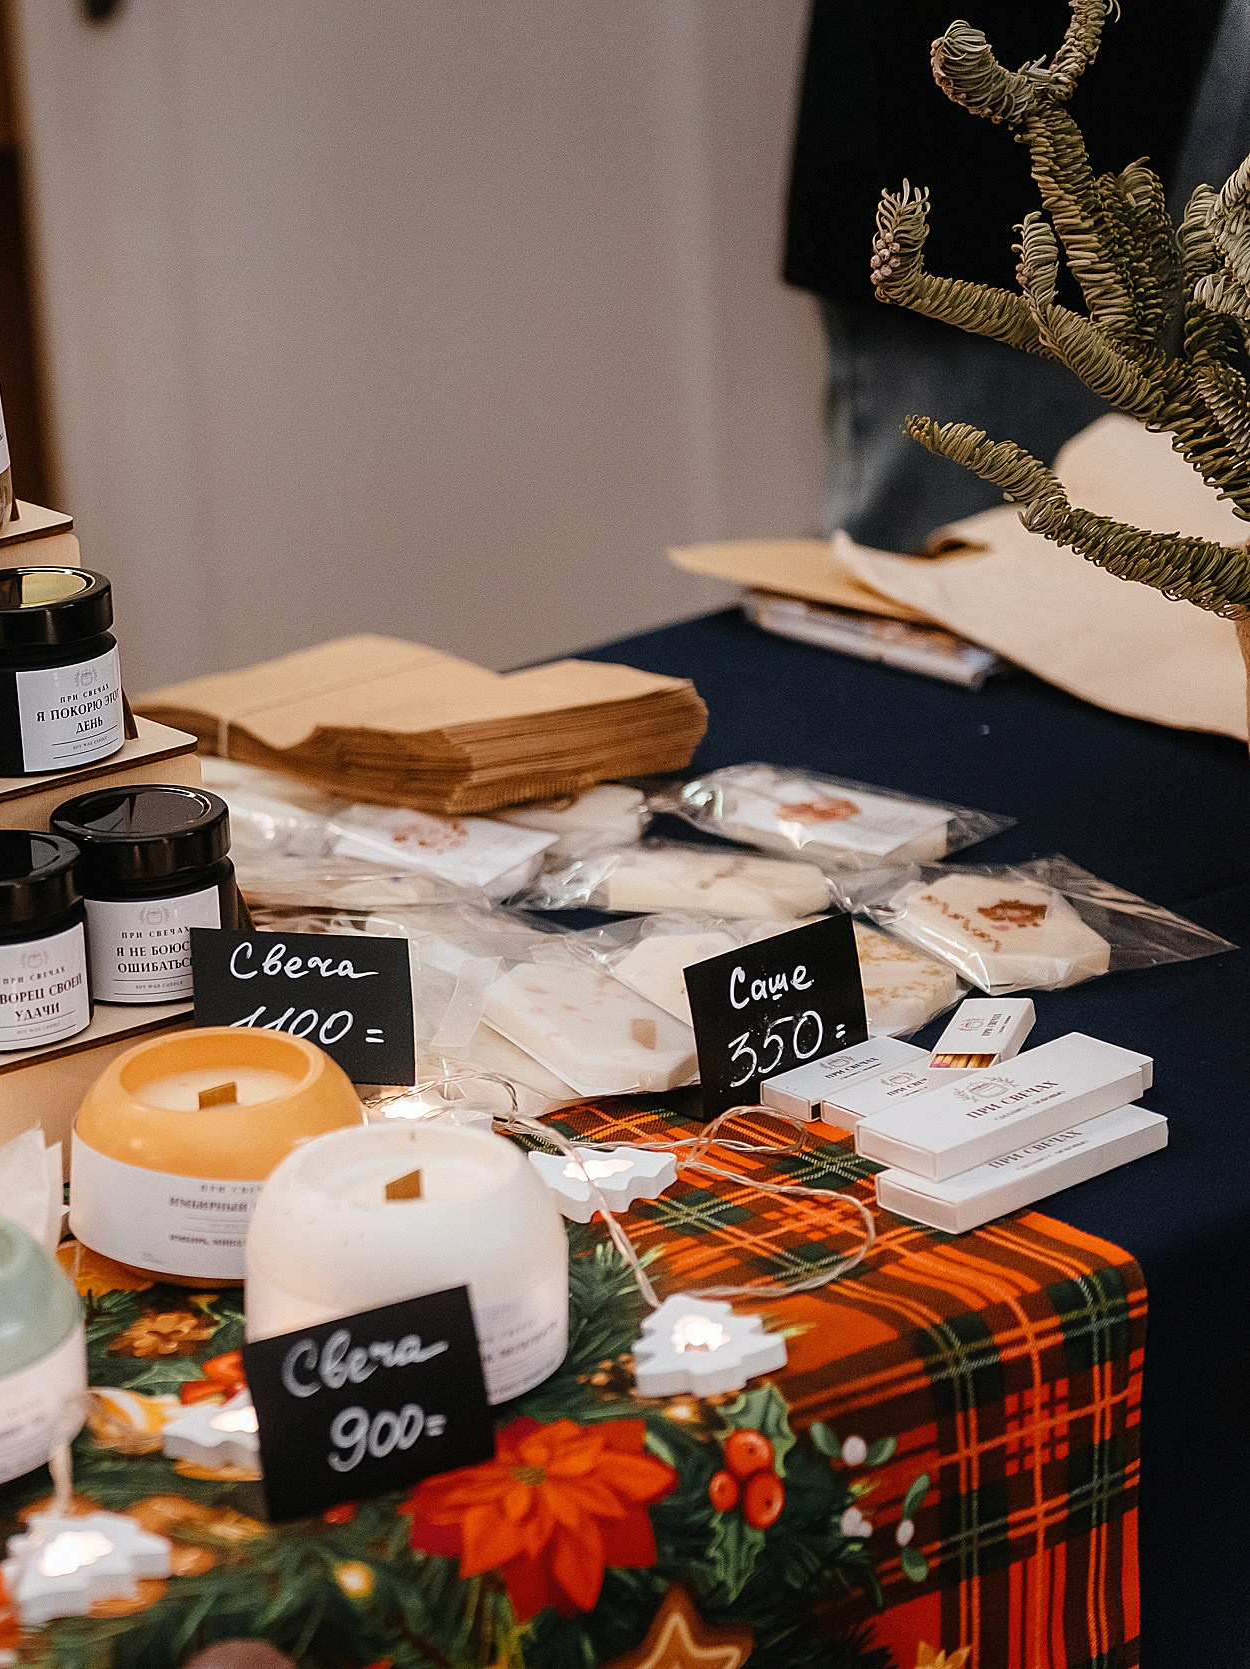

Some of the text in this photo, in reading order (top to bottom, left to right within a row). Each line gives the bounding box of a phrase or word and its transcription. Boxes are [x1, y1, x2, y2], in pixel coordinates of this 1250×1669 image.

[60, 683, 109, 703] ПРИ СВЕЧАХ
[37, 711, 45, 722] Я
[51, 699, 103, 720] ПОКОРЮ
[76, 717, 103, 734] ДЕНЬ
[149, 926, 190, 937] СВЕЧАХ
[117, 941, 190, 957] Я НЕ БОЮС
[230, 942, 379, 979] Свеча
[3, 967, 65, 985] ПРИ СВЕЧАХ
[49, 973, 82, 996] СВОЕЙ
[730, 965, 815, 1009] Саше
[15, 1003, 60, 1021] УДАЧИ
[966, 1081, 1059, 1118] ПРИ СВЕЧАХ
[989, 1153, 1024, 1168] ПРИ
[1024, 1130, 1083, 1154] СВЕЧАХ
[281, 1329, 449, 1398] Свеча
